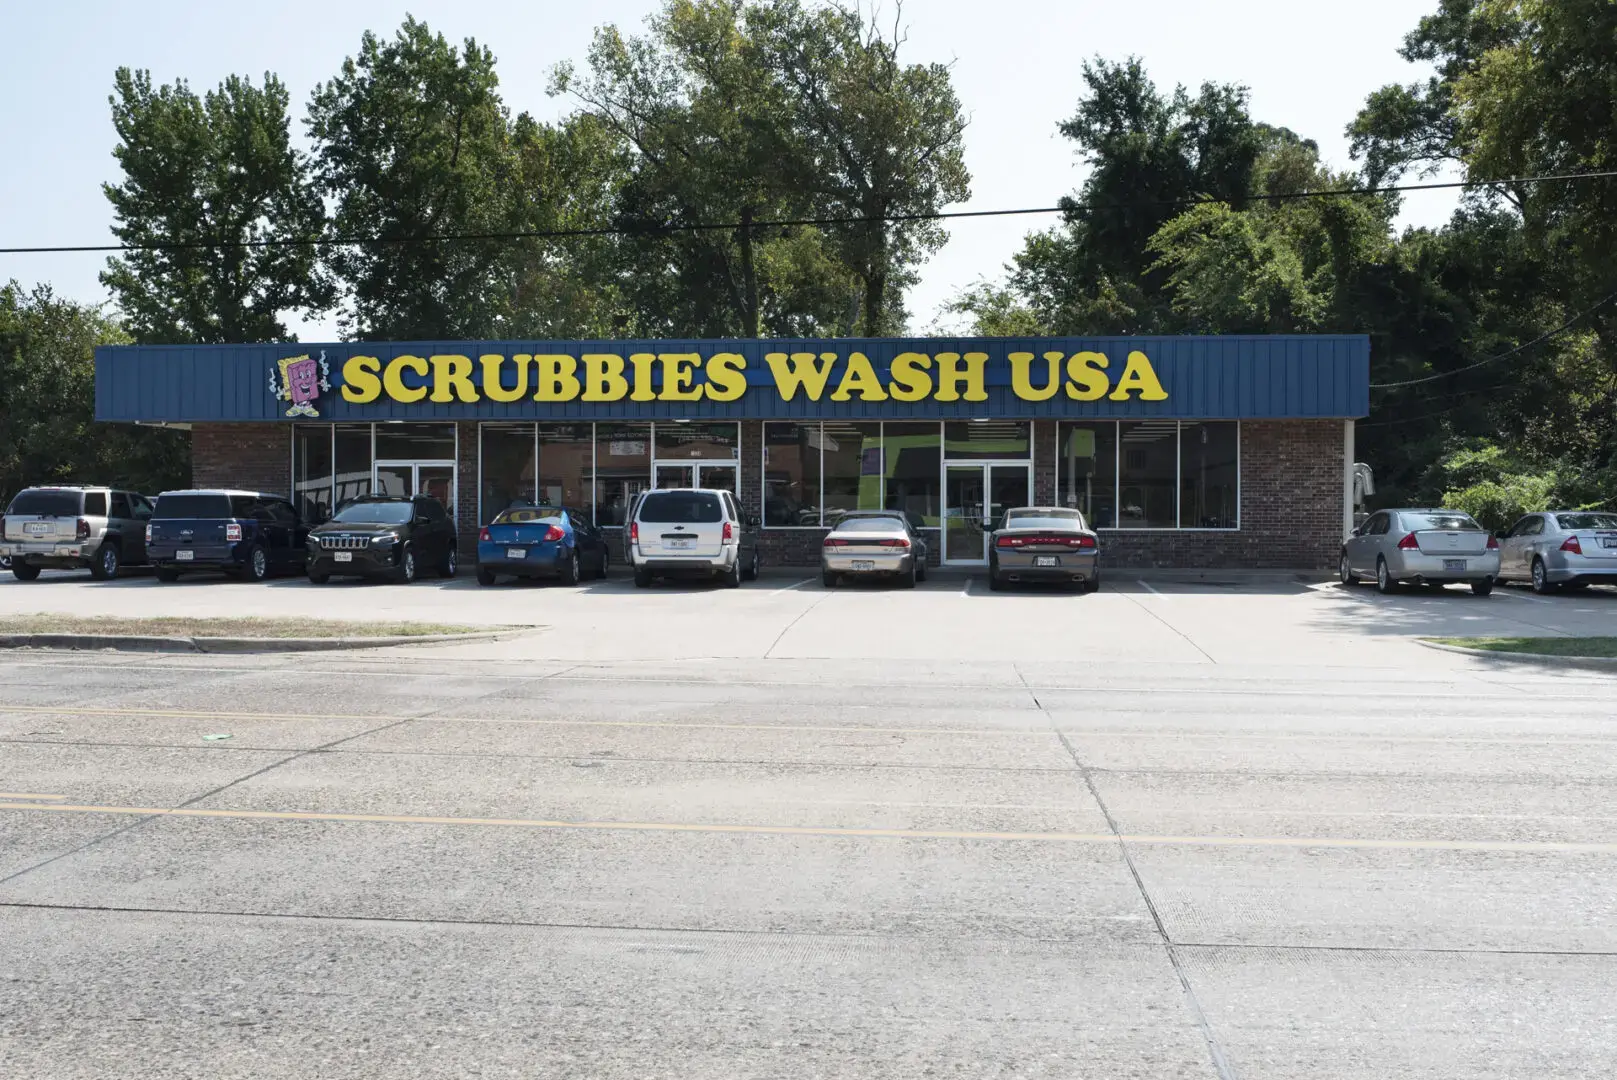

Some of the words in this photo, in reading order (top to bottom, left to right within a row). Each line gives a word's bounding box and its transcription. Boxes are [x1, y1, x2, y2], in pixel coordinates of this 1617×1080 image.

[341, 352, 748, 403] SCRUBBIES
[765, 352, 989, 402] WASH
[1008, 350, 1169, 401] USA
